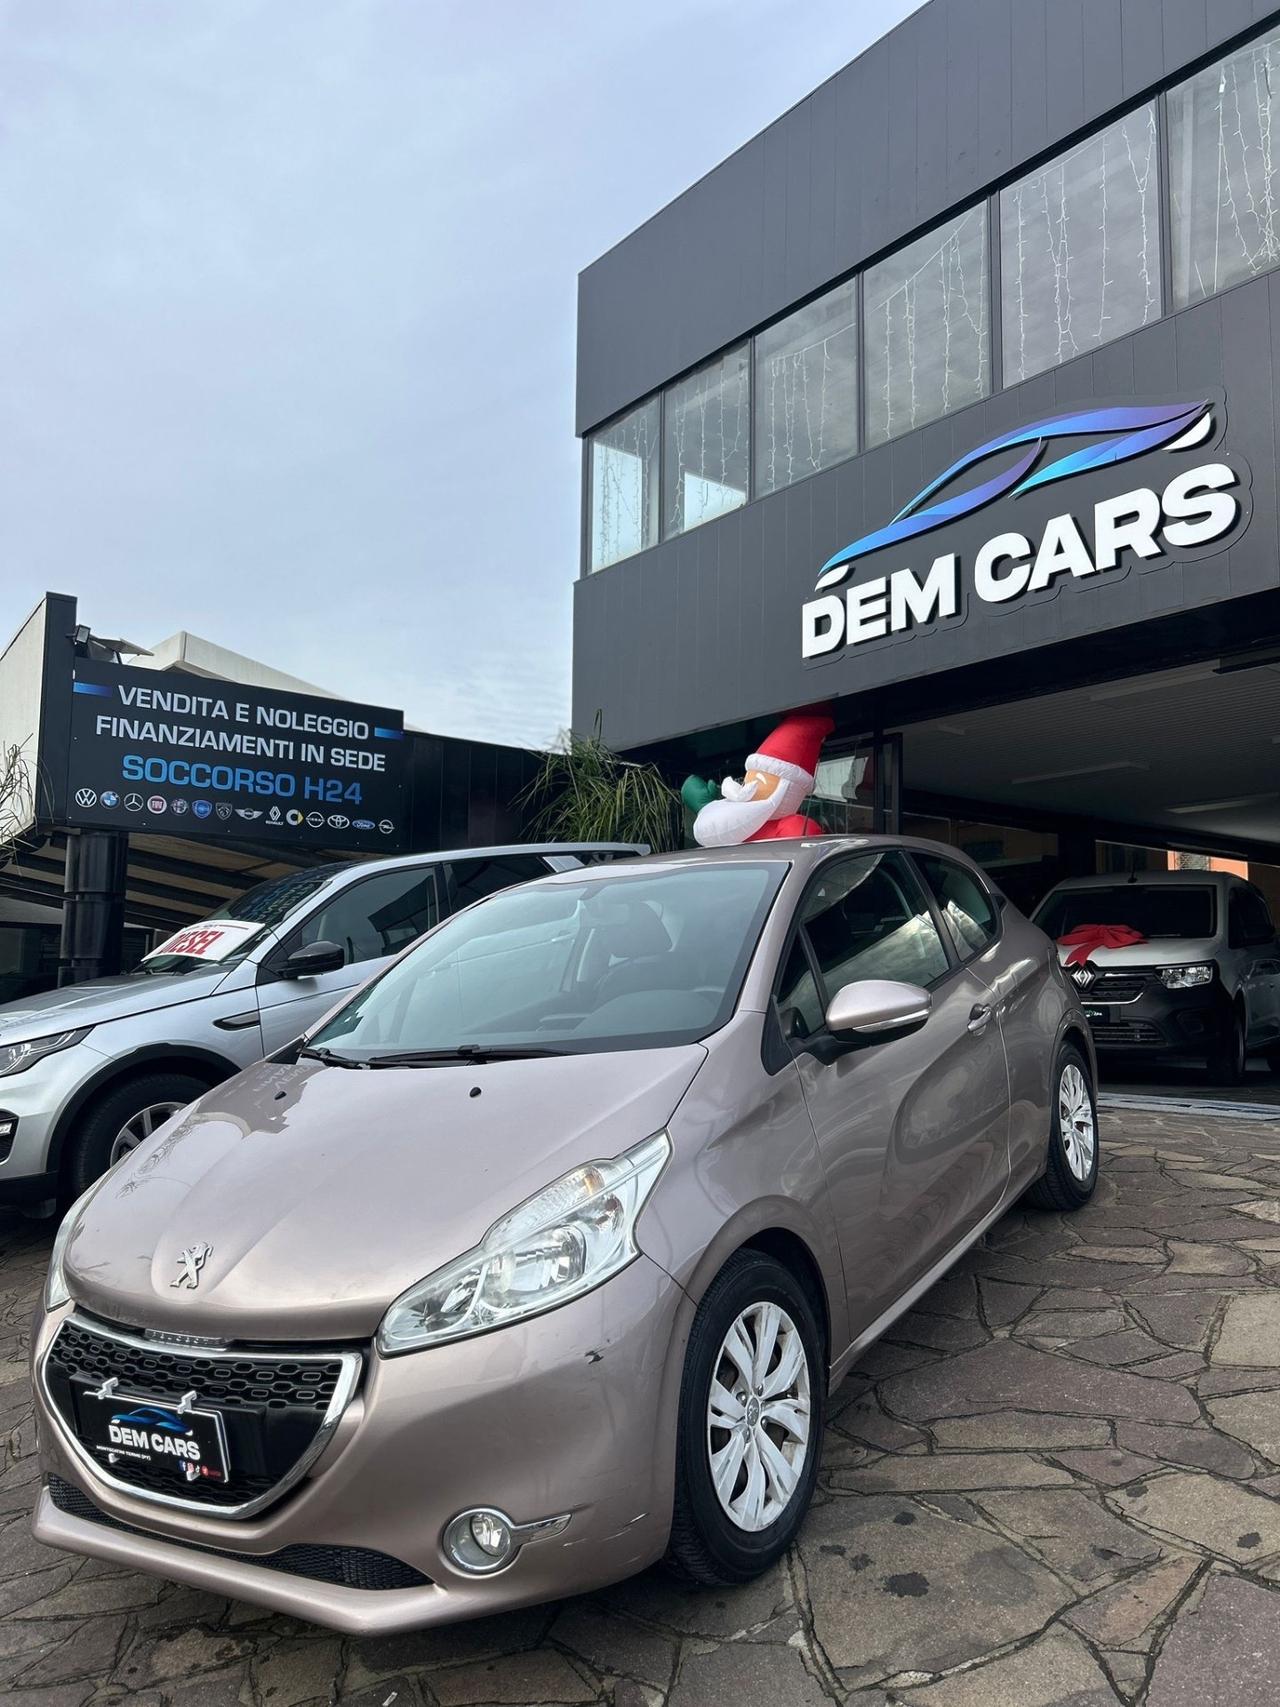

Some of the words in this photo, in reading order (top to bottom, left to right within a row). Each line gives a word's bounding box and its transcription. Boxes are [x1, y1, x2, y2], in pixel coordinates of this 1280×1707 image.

[802, 553, 958, 659] DEM
[974, 462, 1238, 604] CARS
[118, 684, 230, 720] VENDITA
[235, 702, 250, 723] E
[256, 706, 369, 740] NOLEGGIO
[96, 714, 294, 760] FINANZIAMENTI
[301, 743, 325, 764] IN
[330, 748, 386, 772] SEDE
[122, 754, 296, 798] SOCCORSO
[304, 776, 362, 805] H24
[108, 1424, 150, 1450] DEM
[151, 1432, 201, 1461] CARS
